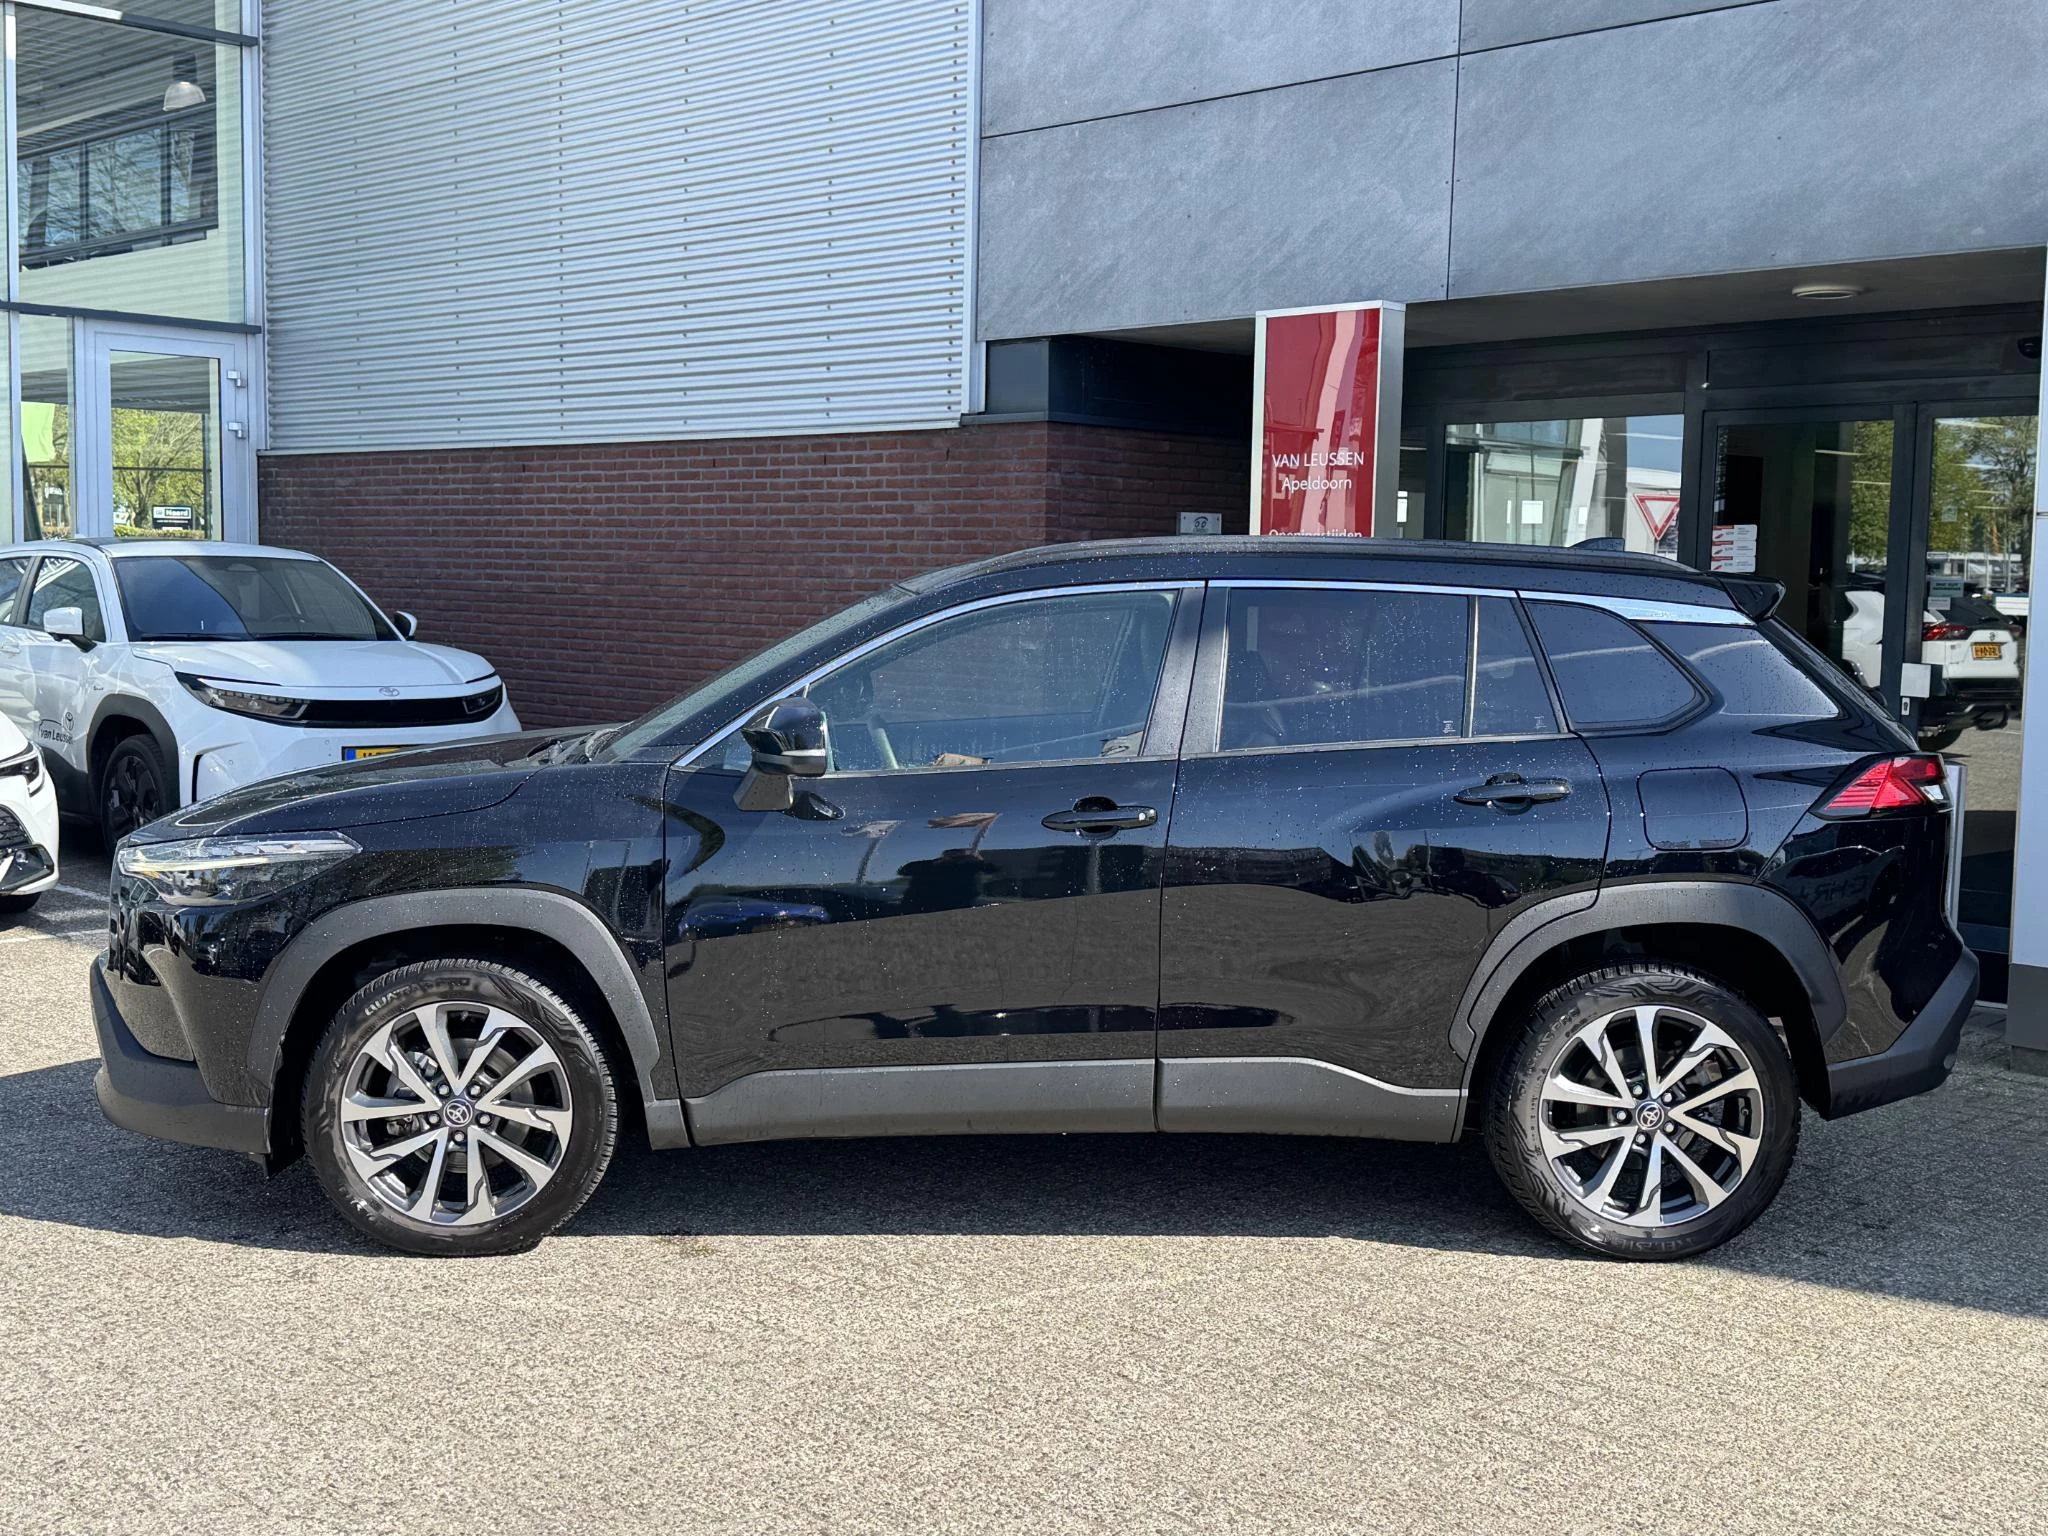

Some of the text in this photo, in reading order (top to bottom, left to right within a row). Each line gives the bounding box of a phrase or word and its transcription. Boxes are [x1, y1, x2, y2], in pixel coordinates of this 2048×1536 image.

[1272, 452, 1364, 467] VAN LEUSSEN
[1281, 477, 1352, 493] Apeldoorn
